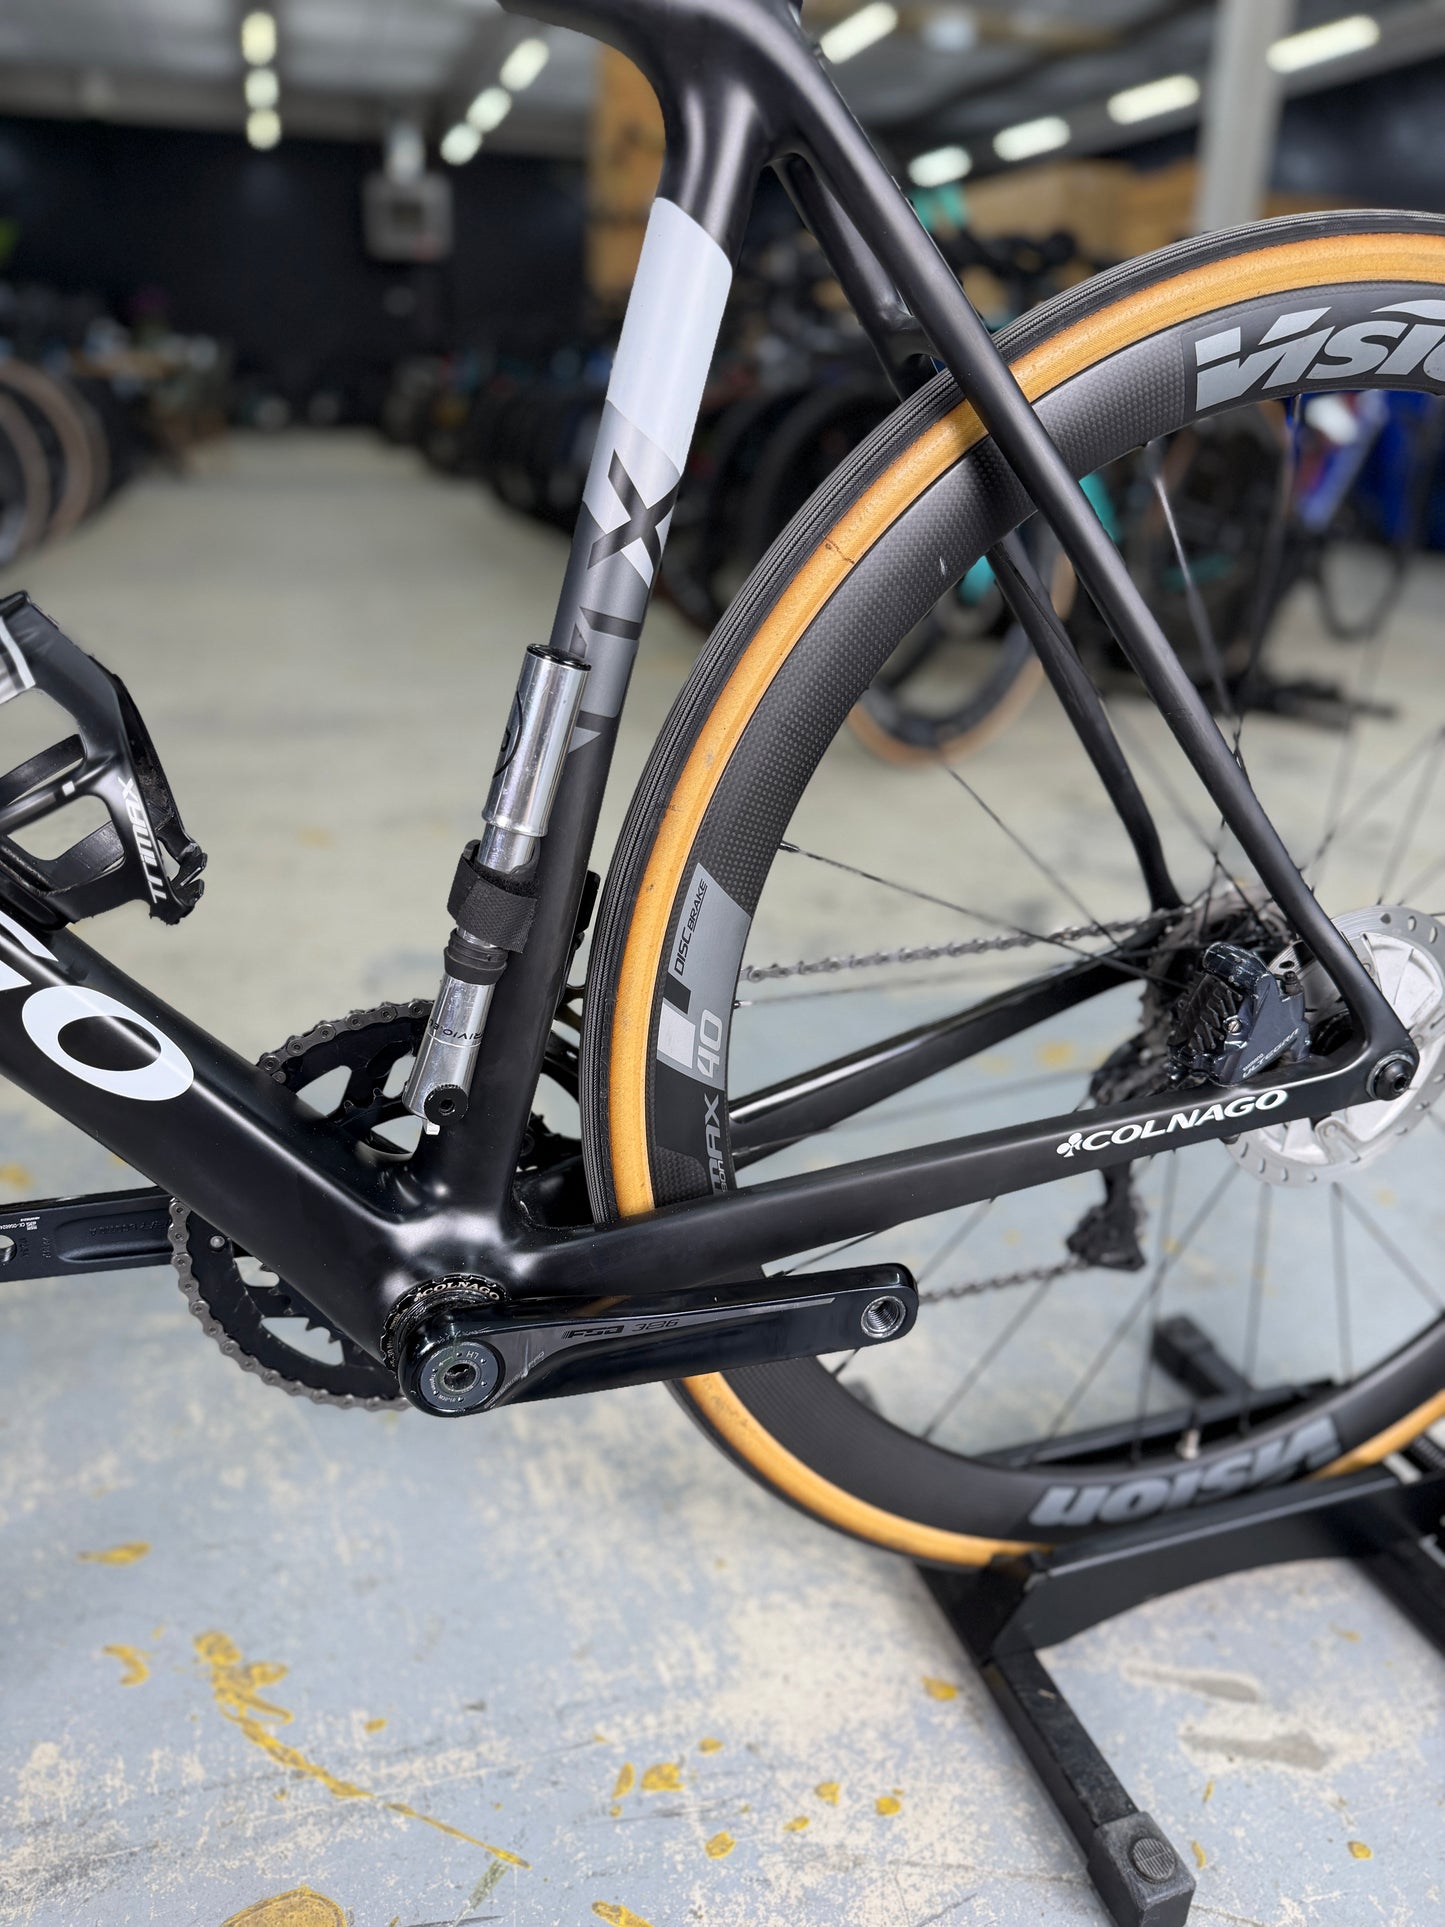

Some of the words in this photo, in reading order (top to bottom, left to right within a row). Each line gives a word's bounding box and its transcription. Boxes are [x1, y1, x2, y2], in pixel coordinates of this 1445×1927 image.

[674, 927, 692, 976] DISC
[688, 879, 709, 933] BRAKE
[697, 1009, 723, 1078] 40
[1242, 1028, 1299, 1078] ULTEGRA
[1082, 1089, 1288, 1152] COLNAGO
[423, 1281, 501, 1301] COLNAGO
